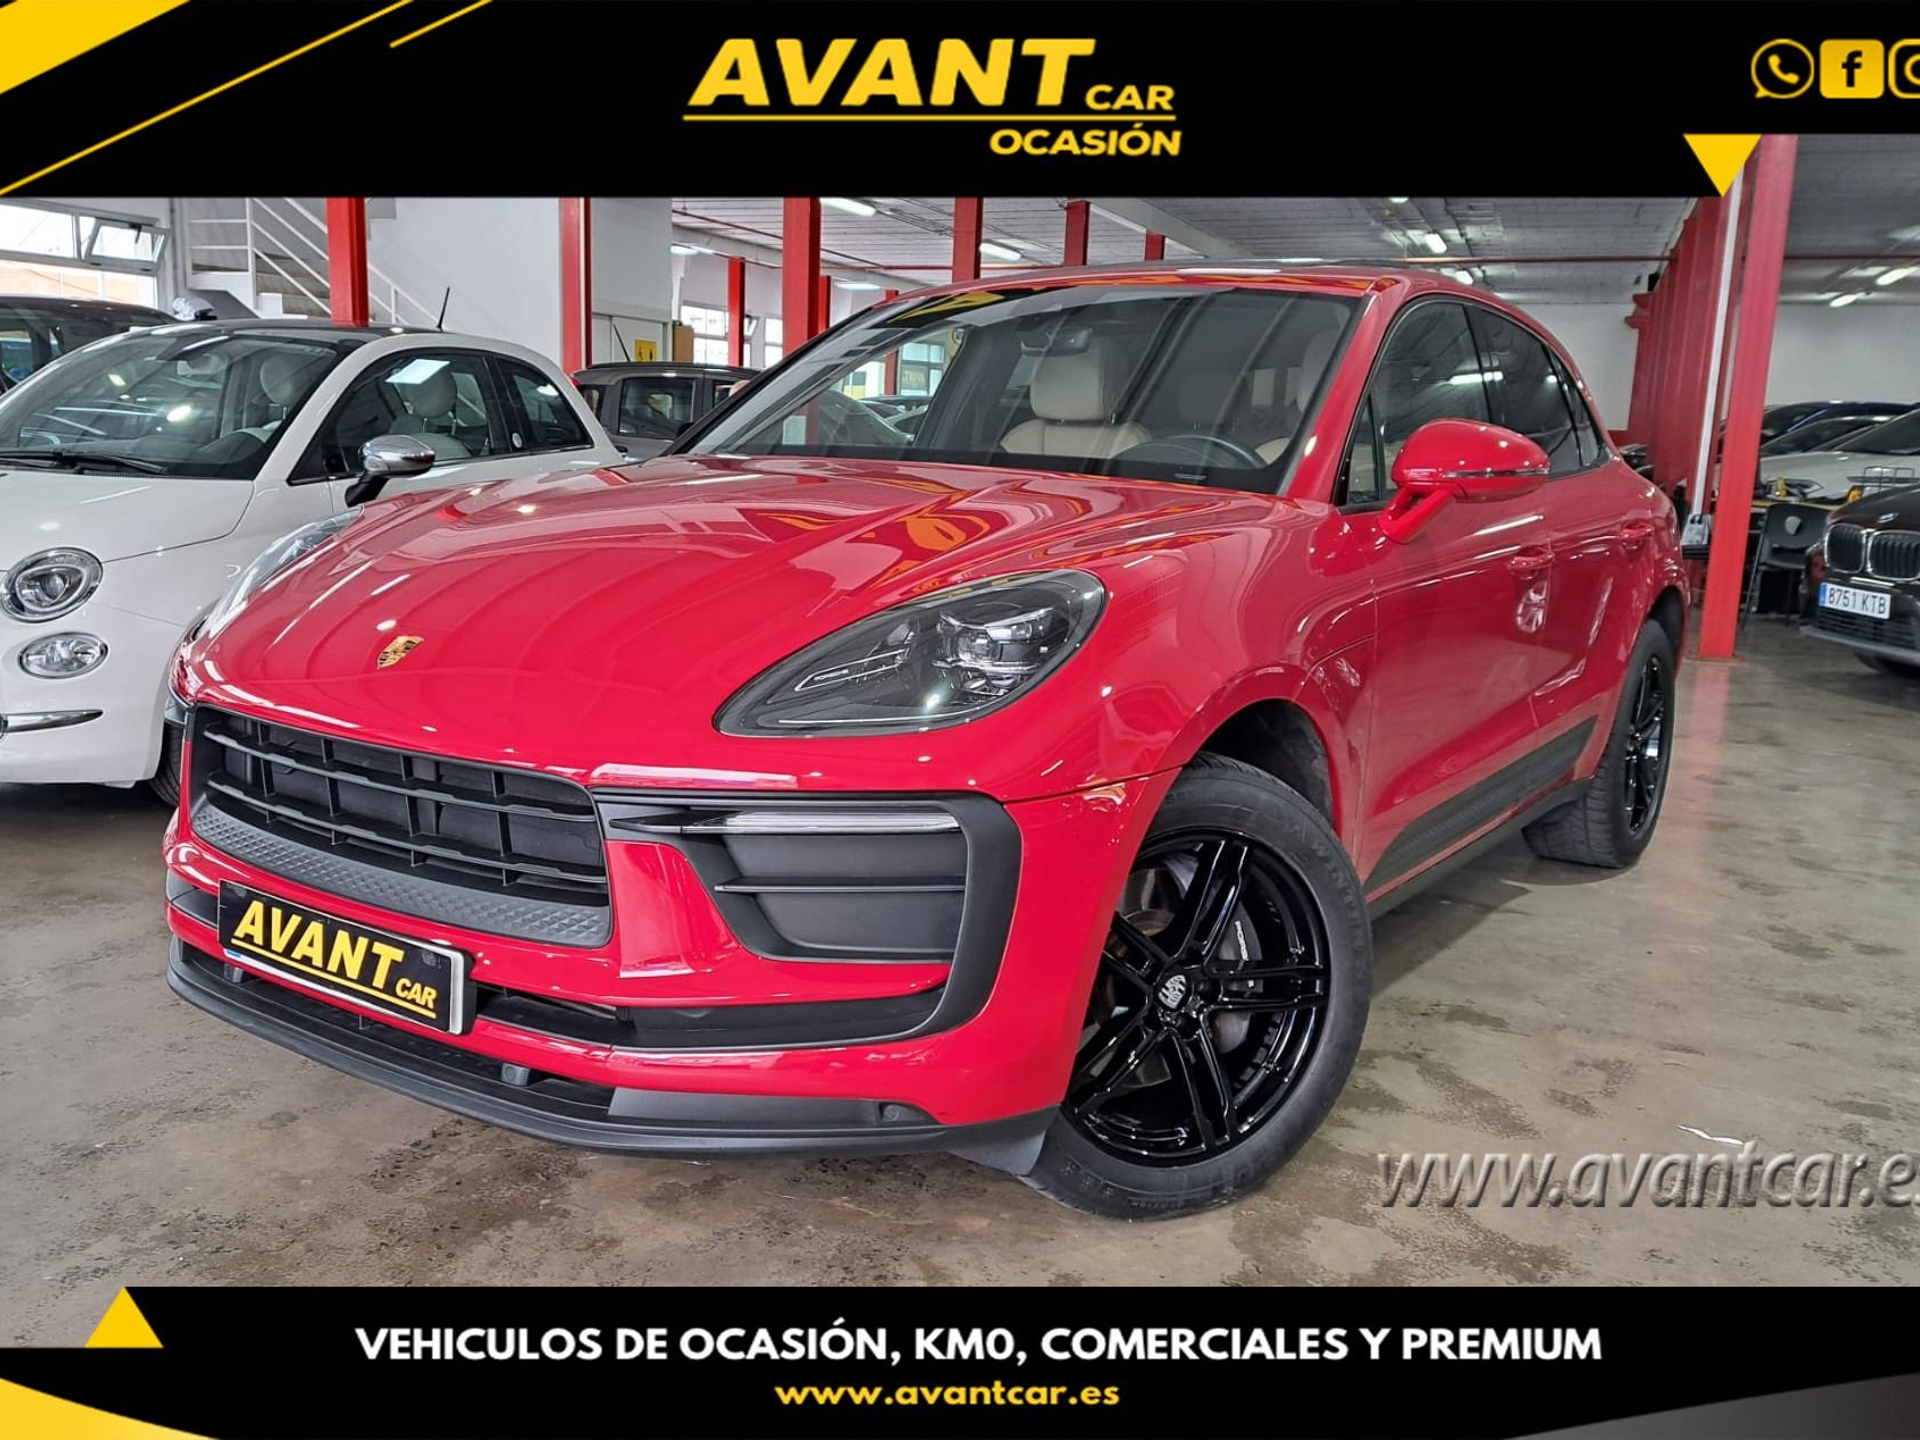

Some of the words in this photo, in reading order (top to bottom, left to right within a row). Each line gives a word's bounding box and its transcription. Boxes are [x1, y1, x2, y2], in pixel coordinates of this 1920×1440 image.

[1828, 587, 1857, 610] 8751
[1862, 592, 1886, 614] KTB
[233, 900, 404, 989] AVANT
[395, 978, 437, 1008] CAR
